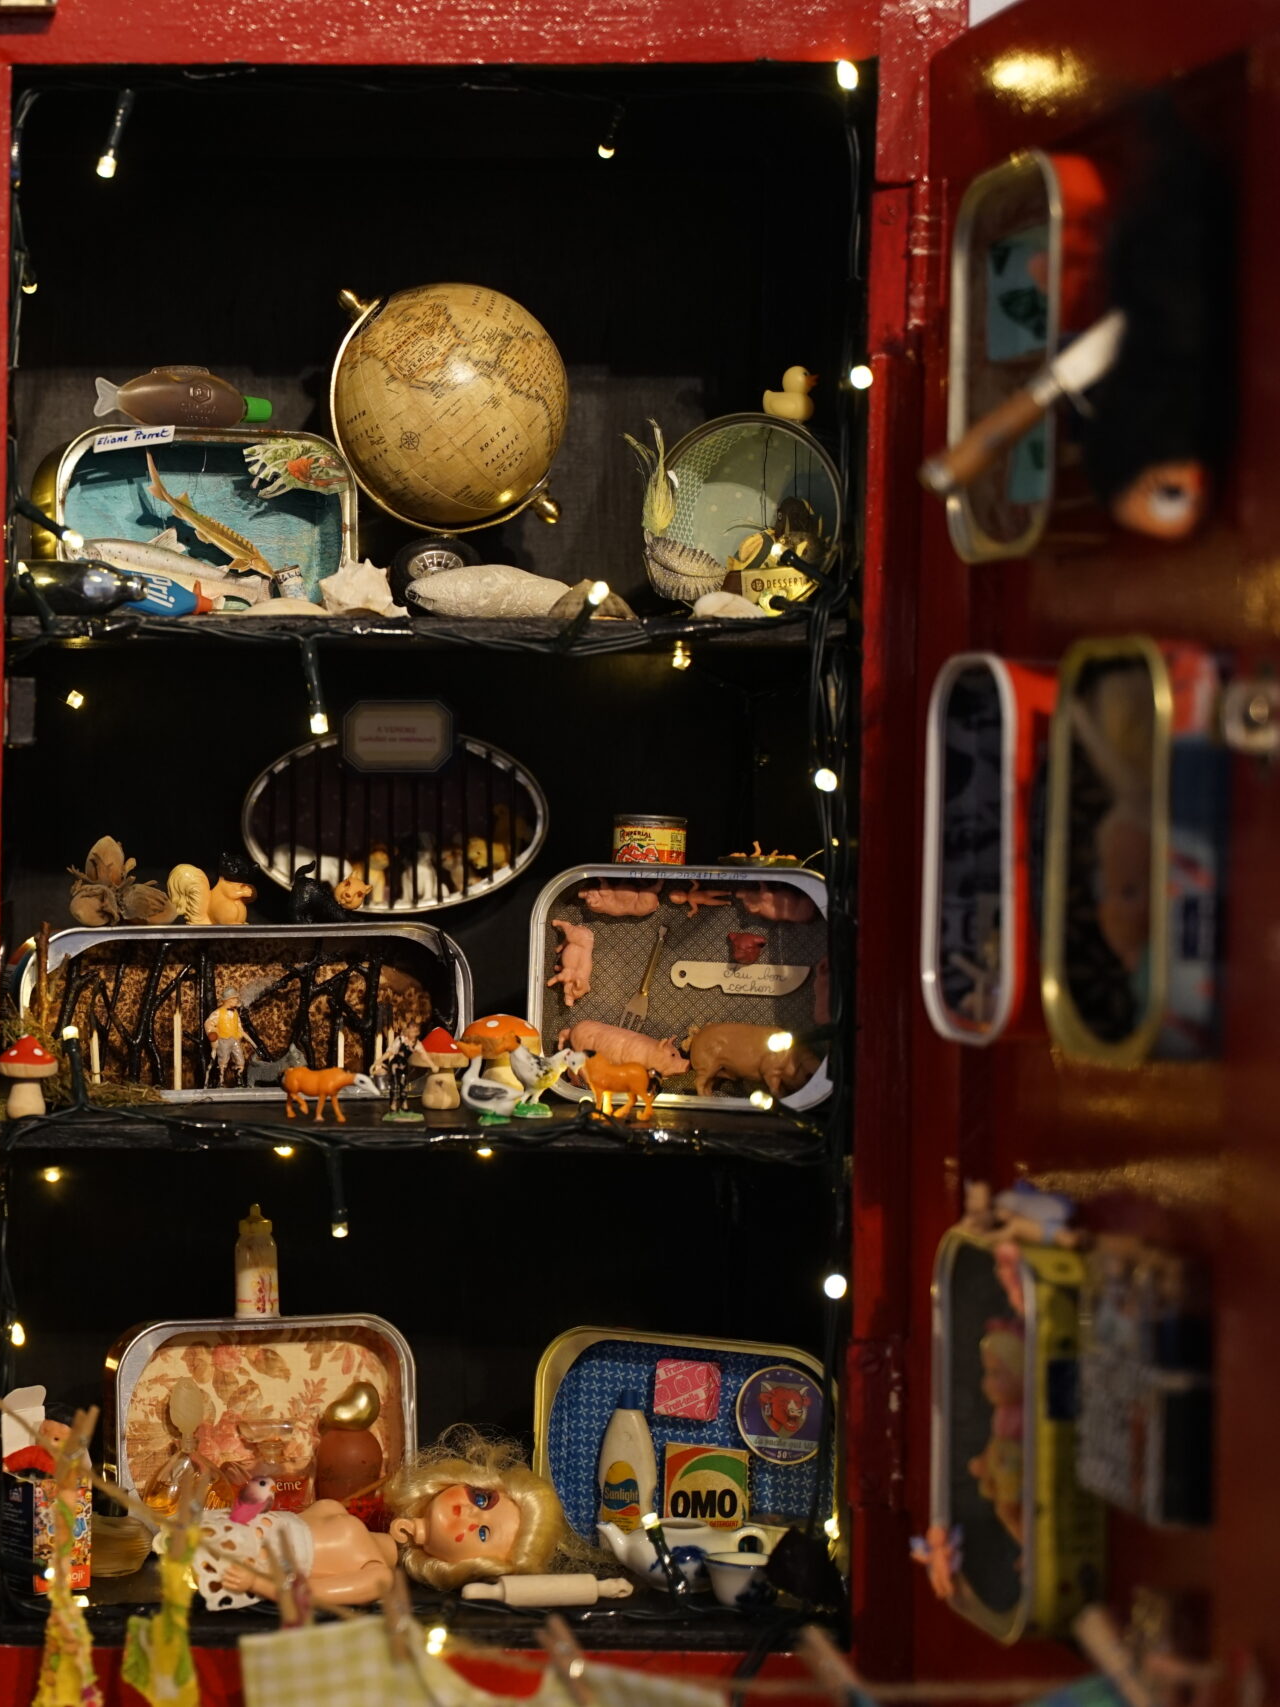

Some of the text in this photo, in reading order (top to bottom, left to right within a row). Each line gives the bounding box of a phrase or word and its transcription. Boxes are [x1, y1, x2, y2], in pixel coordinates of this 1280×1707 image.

[97, 435, 129, 446] Eliane
[479, 426, 507, 452] SOUTH
[485, 433, 520, 468] PACIFIC
[496, 451, 524, 477] OCEAN
[141, 574, 177, 609] Pril
[766, 577, 804, 590] DESSERT
[726, 981, 776, 994] cochon
[604, 1487, 639, 1503] Sunlight
[671, 1489, 738, 1518] OMO
[709, 1520, 739, 1528] DETERGENT
